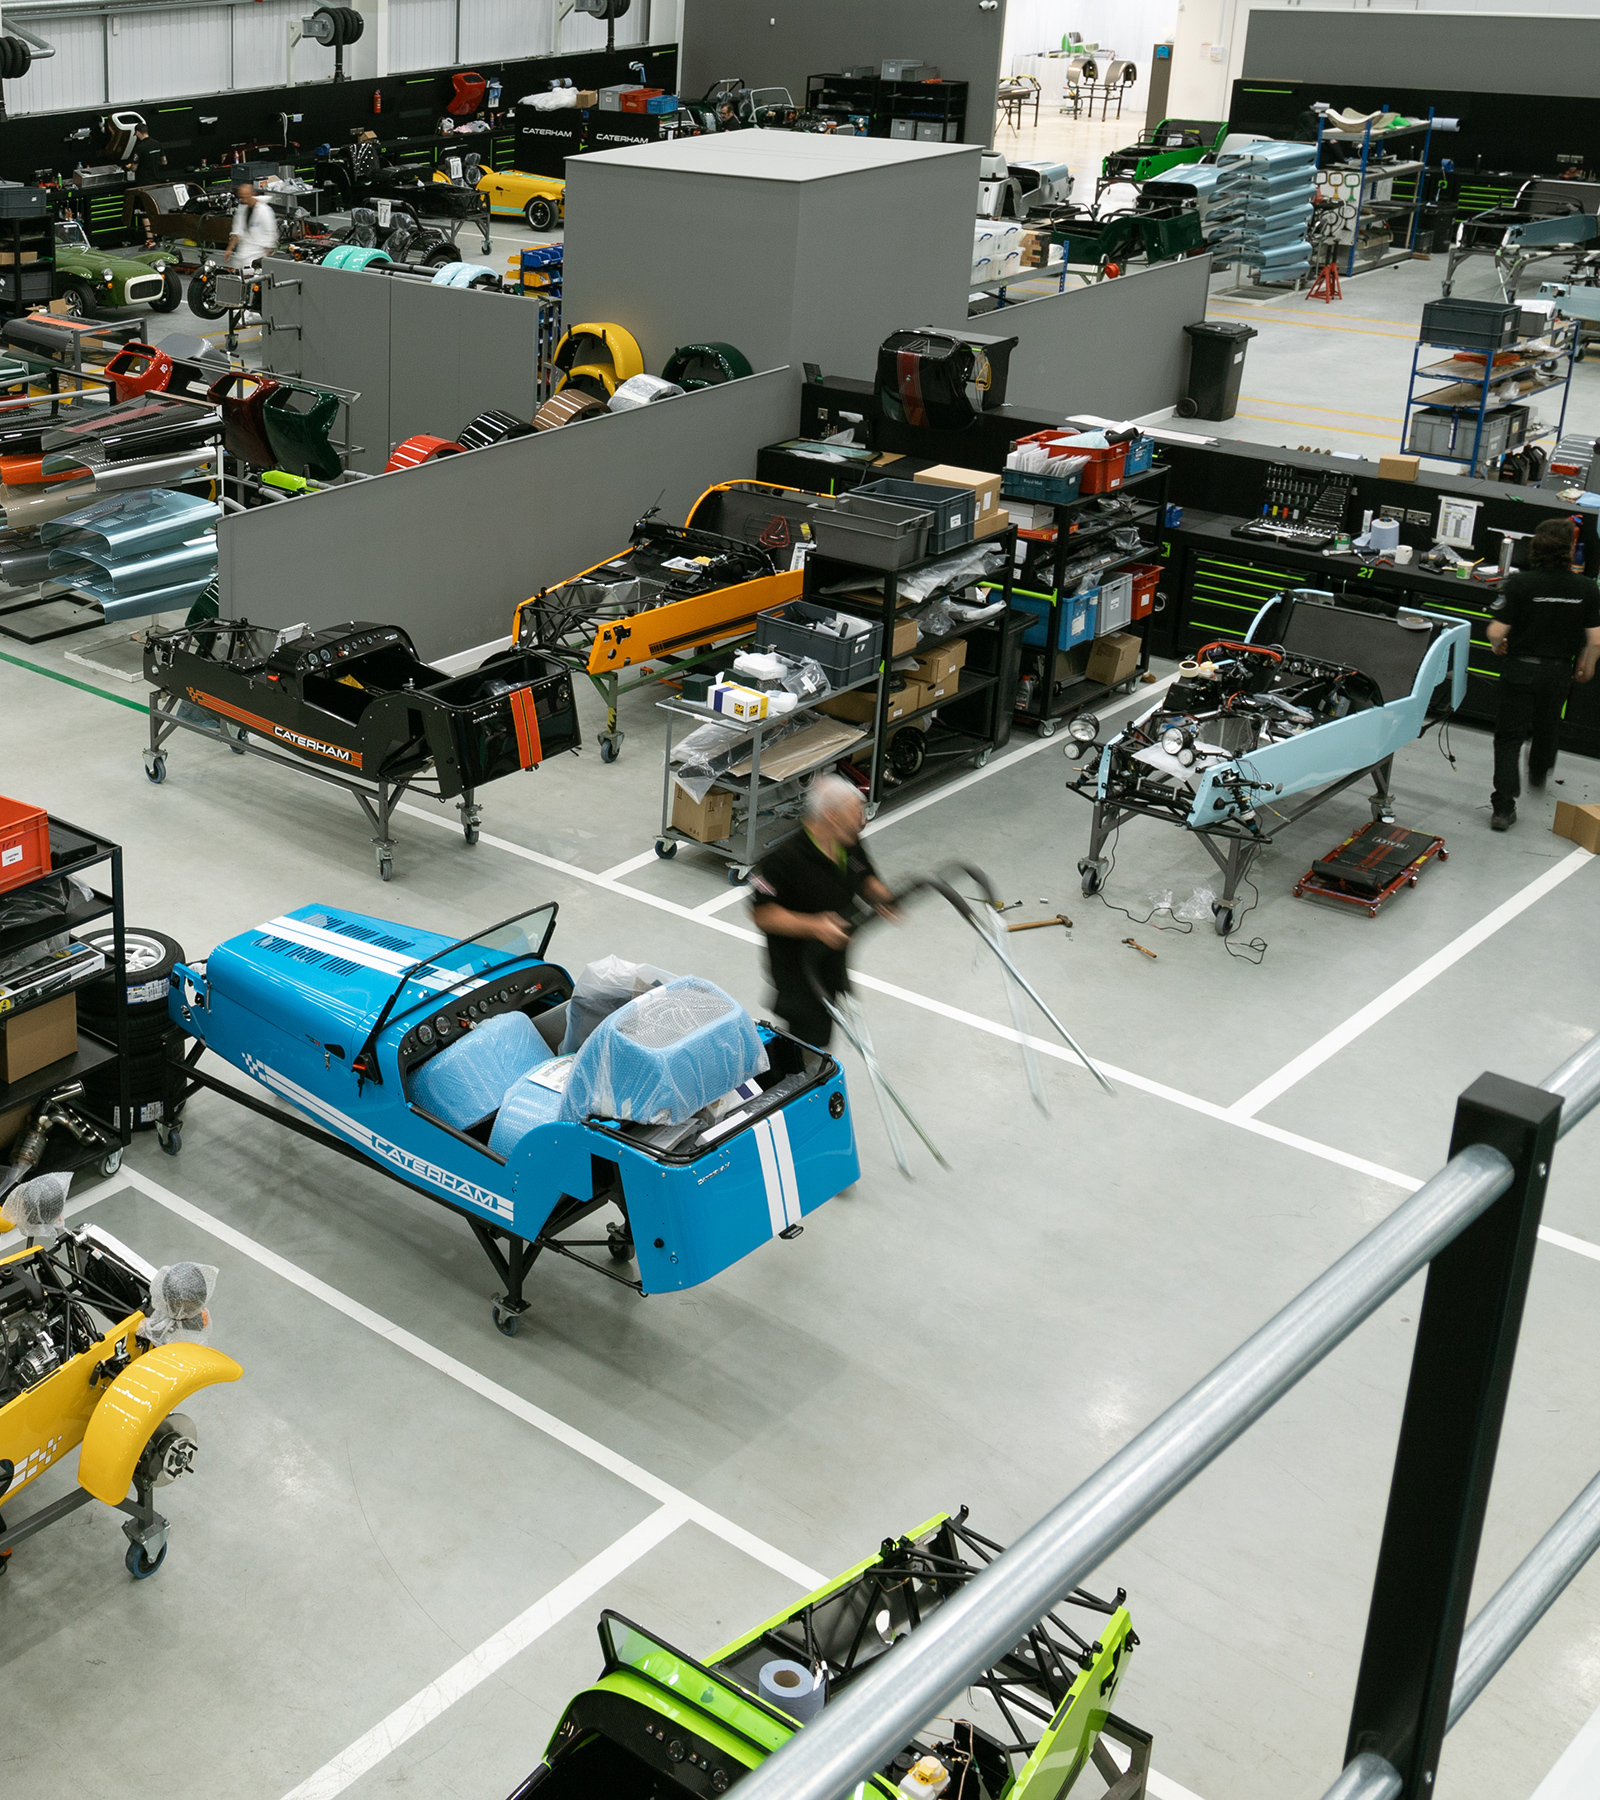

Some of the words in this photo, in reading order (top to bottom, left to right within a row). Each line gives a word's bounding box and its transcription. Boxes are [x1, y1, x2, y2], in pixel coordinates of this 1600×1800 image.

[522, 127, 572, 138] CATERHAM
[596, 133, 649, 144] CATERHAM
[1357, 566, 1375, 579] 21
[274, 726, 350, 761] CATERHAM
[373, 1137, 497, 1209] CATERHAM
